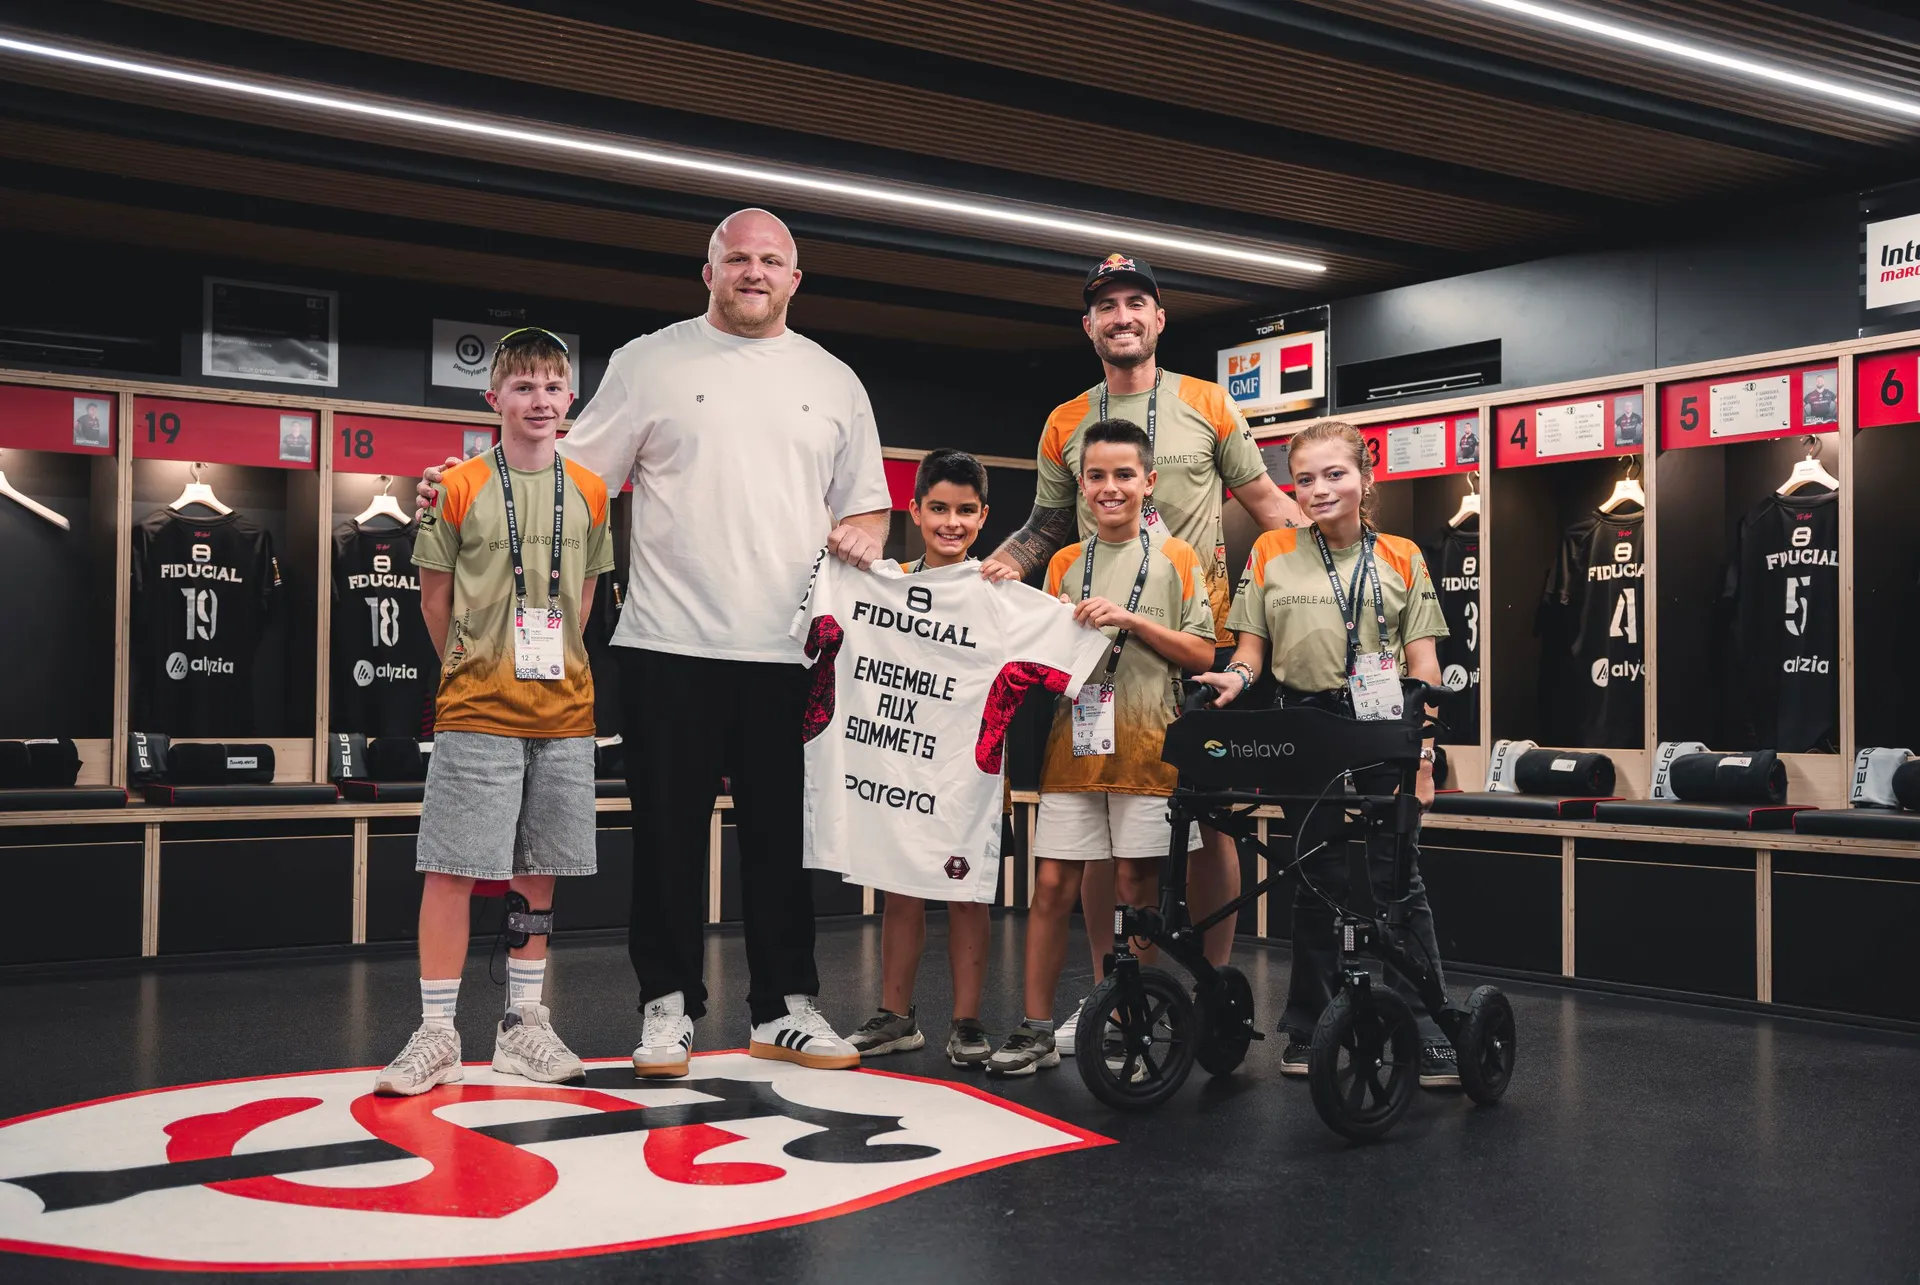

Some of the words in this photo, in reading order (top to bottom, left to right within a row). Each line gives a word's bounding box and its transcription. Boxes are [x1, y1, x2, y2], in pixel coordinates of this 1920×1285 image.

[452, 363, 488, 377] pennylane
[1230, 376, 1259, 396] GMF
[1880, 368, 1905, 407] 6
[1679, 396, 1699, 431] 5
[145, 411, 181, 444] 19
[1510, 418, 1528, 450] 4
[341, 427, 374, 459] 18
[1367, 437, 1380, 467] 3
[500, 466, 509, 488] BLANCO
[508, 509, 516, 529] SERGE
[511, 529, 519, 554] BLANCO
[161, 563, 243, 583] FIDUCIAL
[1272, 595, 1318, 609] ENSEMBLE
[1319, 595, 1338, 606] AUX
[1331, 576, 1340, 590] SERGE
[1336, 589, 1347, 612] BLANCO
[1785, 575, 1811, 637] 5
[180, 587, 218, 641] 19
[364, 597, 400, 647] 18
[547, 608, 563, 619] 26
[547, 618, 562, 629] 27
[851, 600, 977, 649] FIDUCIAL
[1609, 588, 1637, 644] 4
[1464, 601, 1479, 652] 3
[190, 655, 234, 676] alyzia
[521, 654, 529, 662] 12
[1378, 650, 1394, 660] 26
[1380, 659, 1394, 671] 27
[375, 662, 418, 682] alyzia
[853, 655, 957, 702] ENSEMBLE
[1099, 692, 1113, 703] 27
[1100, 683, 1114, 693] 26
[876, 693, 919, 725] AUX
[844, 715, 937, 760] SOMMETS
[1230, 739, 1295, 758] helavo
